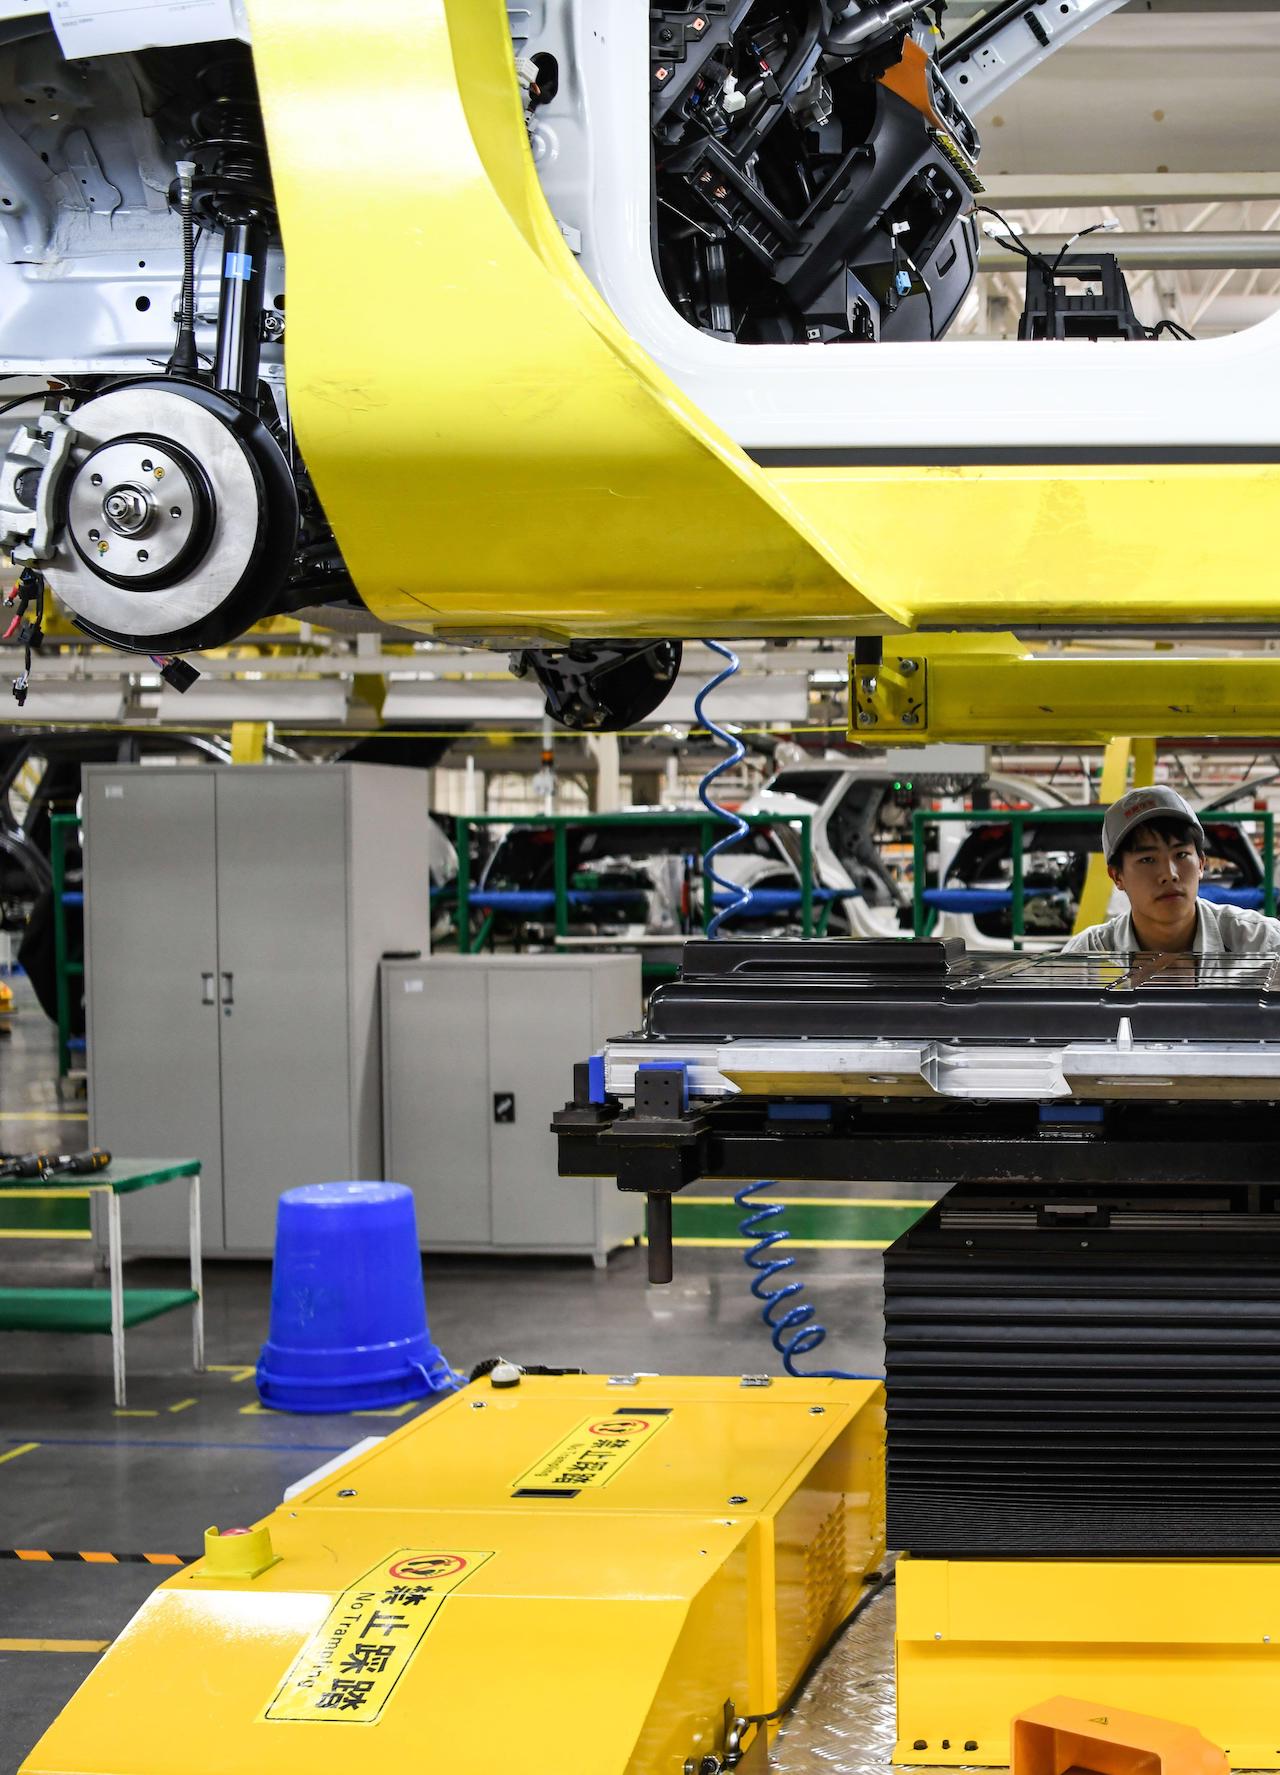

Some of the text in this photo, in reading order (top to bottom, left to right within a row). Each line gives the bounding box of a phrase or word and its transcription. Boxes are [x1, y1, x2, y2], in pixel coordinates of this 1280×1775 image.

[551, 1439, 630, 1484] 禁止踩踏
[297, 1592, 375, 1688] No Trampling
[315, 1585, 434, 1711] 禁止踩踏
